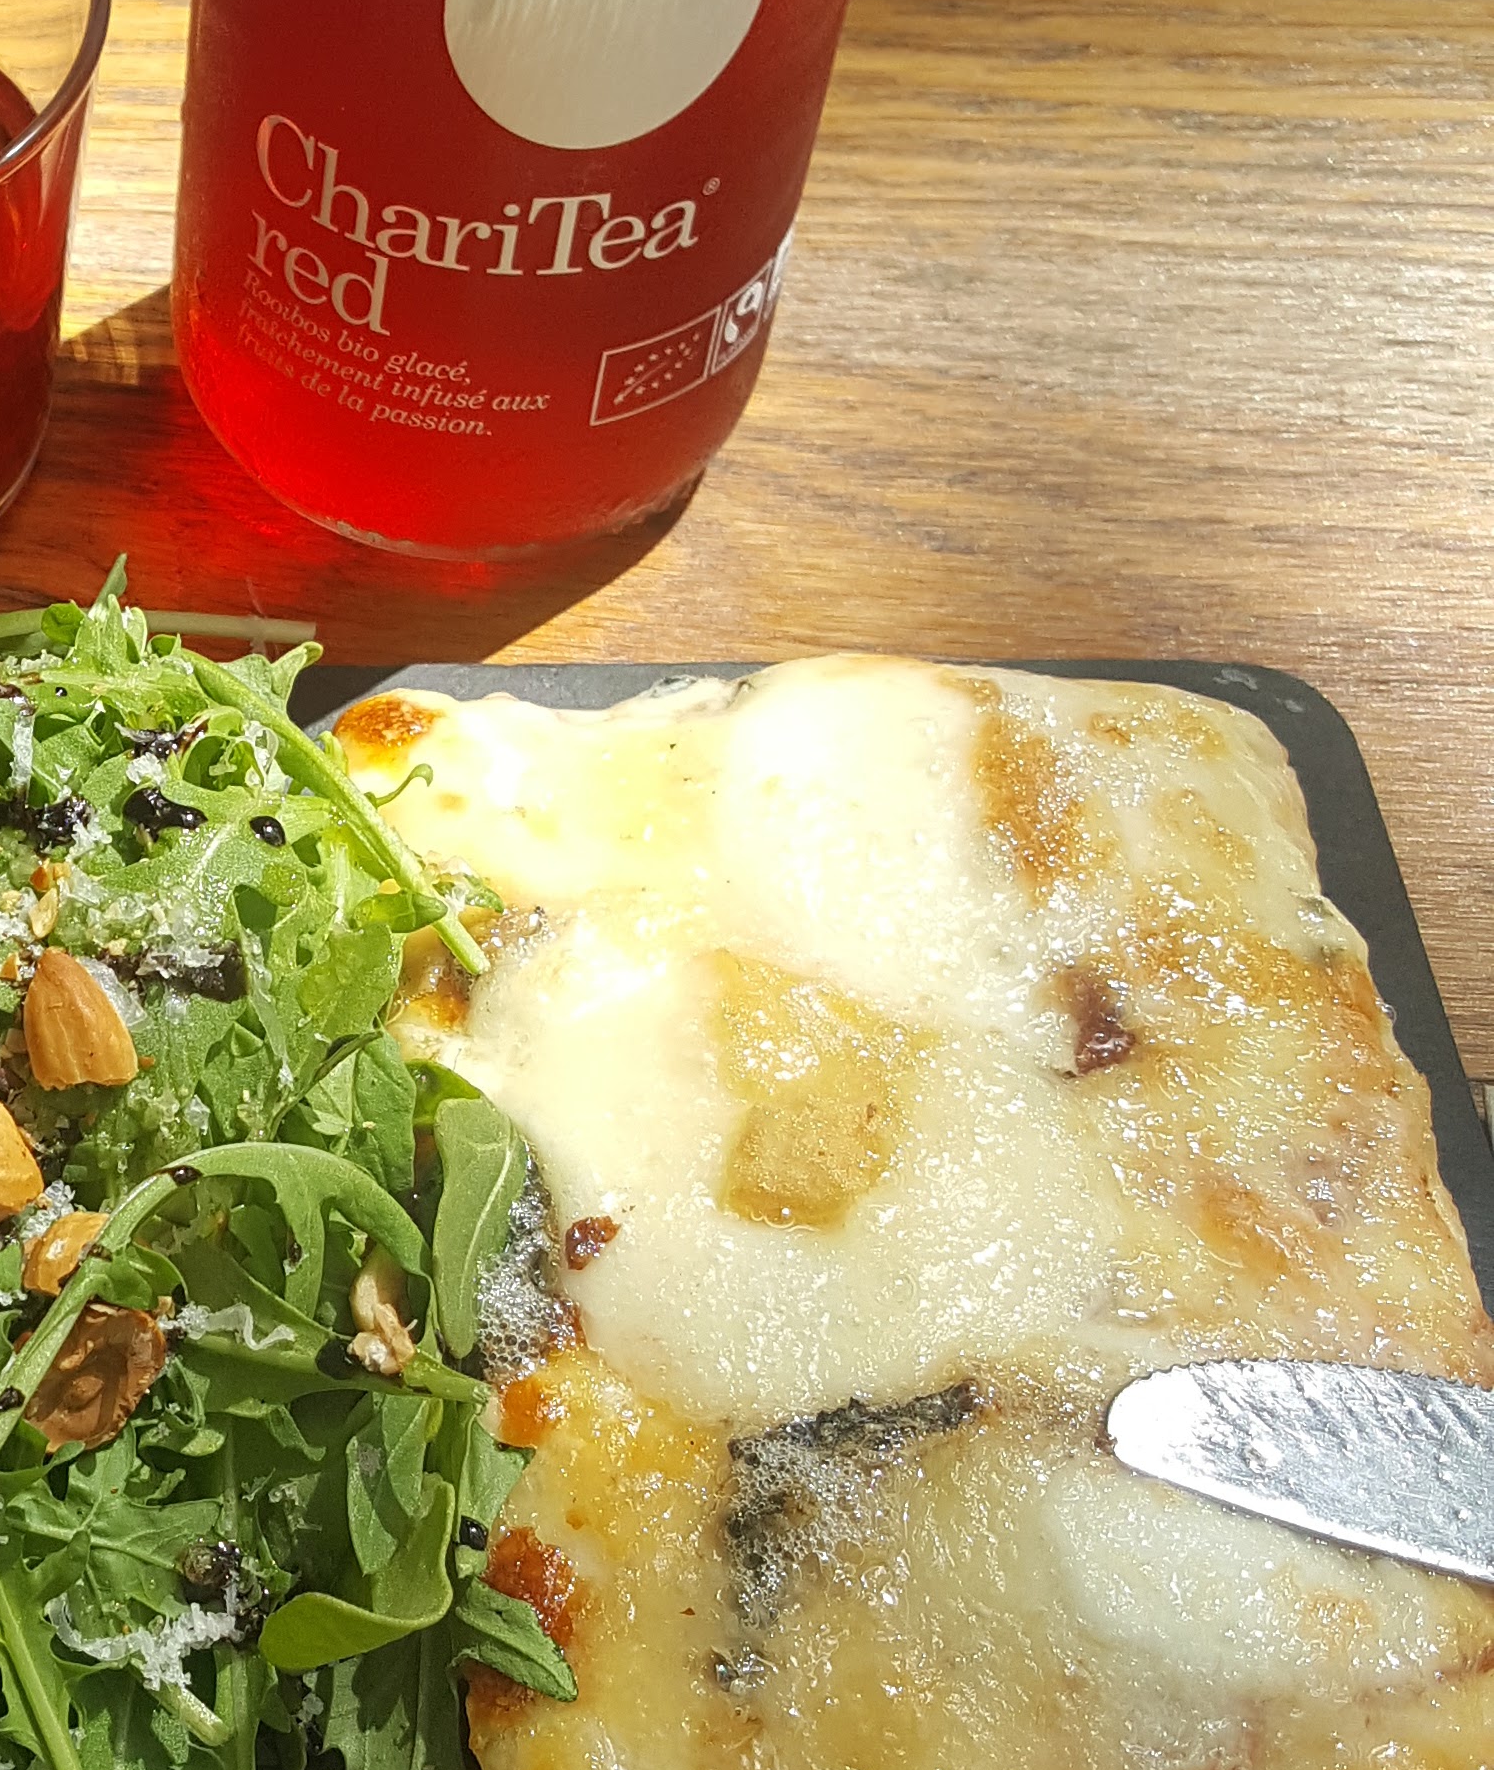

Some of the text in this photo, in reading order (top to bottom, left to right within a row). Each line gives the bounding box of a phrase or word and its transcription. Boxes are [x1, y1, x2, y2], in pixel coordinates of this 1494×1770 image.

[247, 209, 391, 336] red
[244, 269, 471, 385] Rooibos bio glacé,
[301, 372, 331, 397] de
[337, 385, 364, 412] la
[369, 402, 493, 436] passion.
[392, 376, 487, 410] infusé
[492, 394, 551, 412] aux
